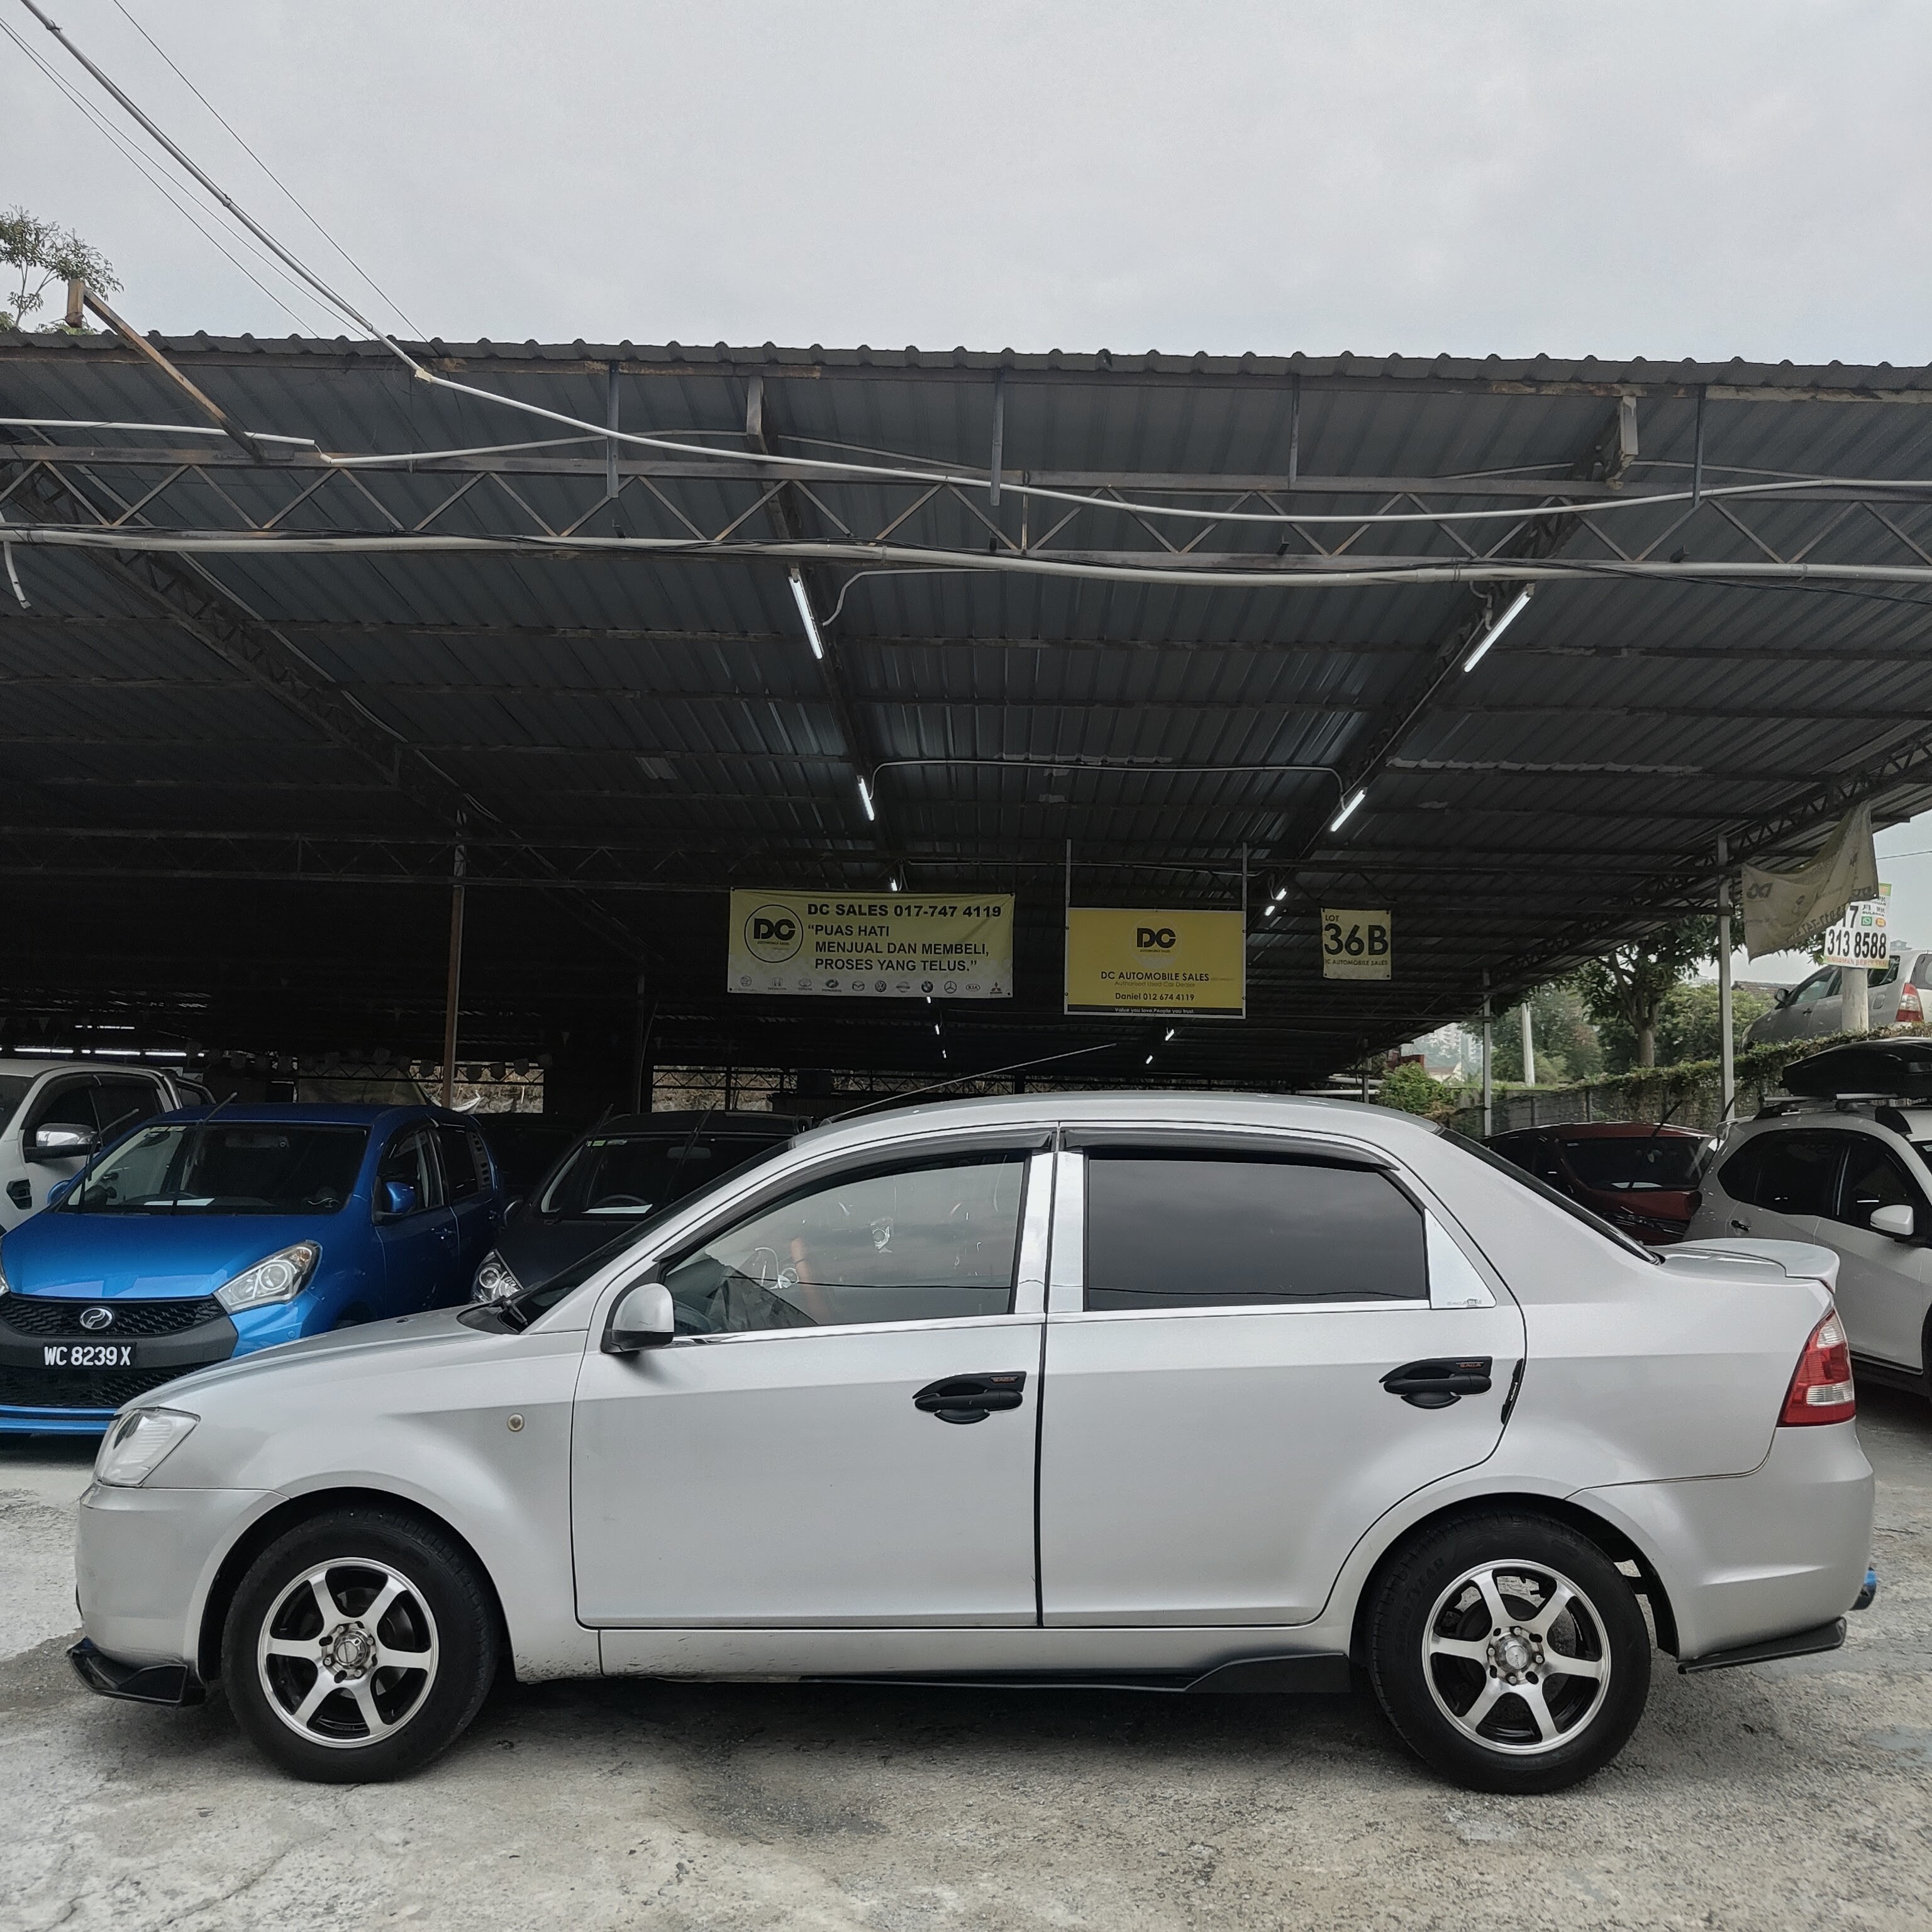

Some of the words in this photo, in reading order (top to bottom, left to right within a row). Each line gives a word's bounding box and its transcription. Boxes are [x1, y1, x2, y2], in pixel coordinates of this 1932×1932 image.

[808, 904, 830, 916] DC
[835, 904, 888, 916] SALES
[894, 906, 957, 918] 017-747
[963, 906, 1001, 918] 4119
[754, 918, 796, 941] DC
[858, 925, 889, 936] HATI
[1136, 928, 1176, 948] DC
[1324, 923, 1389, 956] 36B
[1828, 929, 1850, 957] 313
[1854, 931, 1887, 960] 8588
[815, 941, 882, 954] MENJUAL
[887, 943, 918, 954] DAN
[921, 943, 989, 957] MEMBELI,
[815, 958, 873, 970] PROSES
[879, 959, 916, 971] YANG
[1119, 972, 1179, 980] AUTOMOBILE
[1182, 973, 1209, 981] SALES
[1115, 992, 1141, 1001] Daniel
[45, 1346, 67, 1365] WC
[70, 1346, 117, 1366] 8239
[119, 1346, 131, 1366] X
